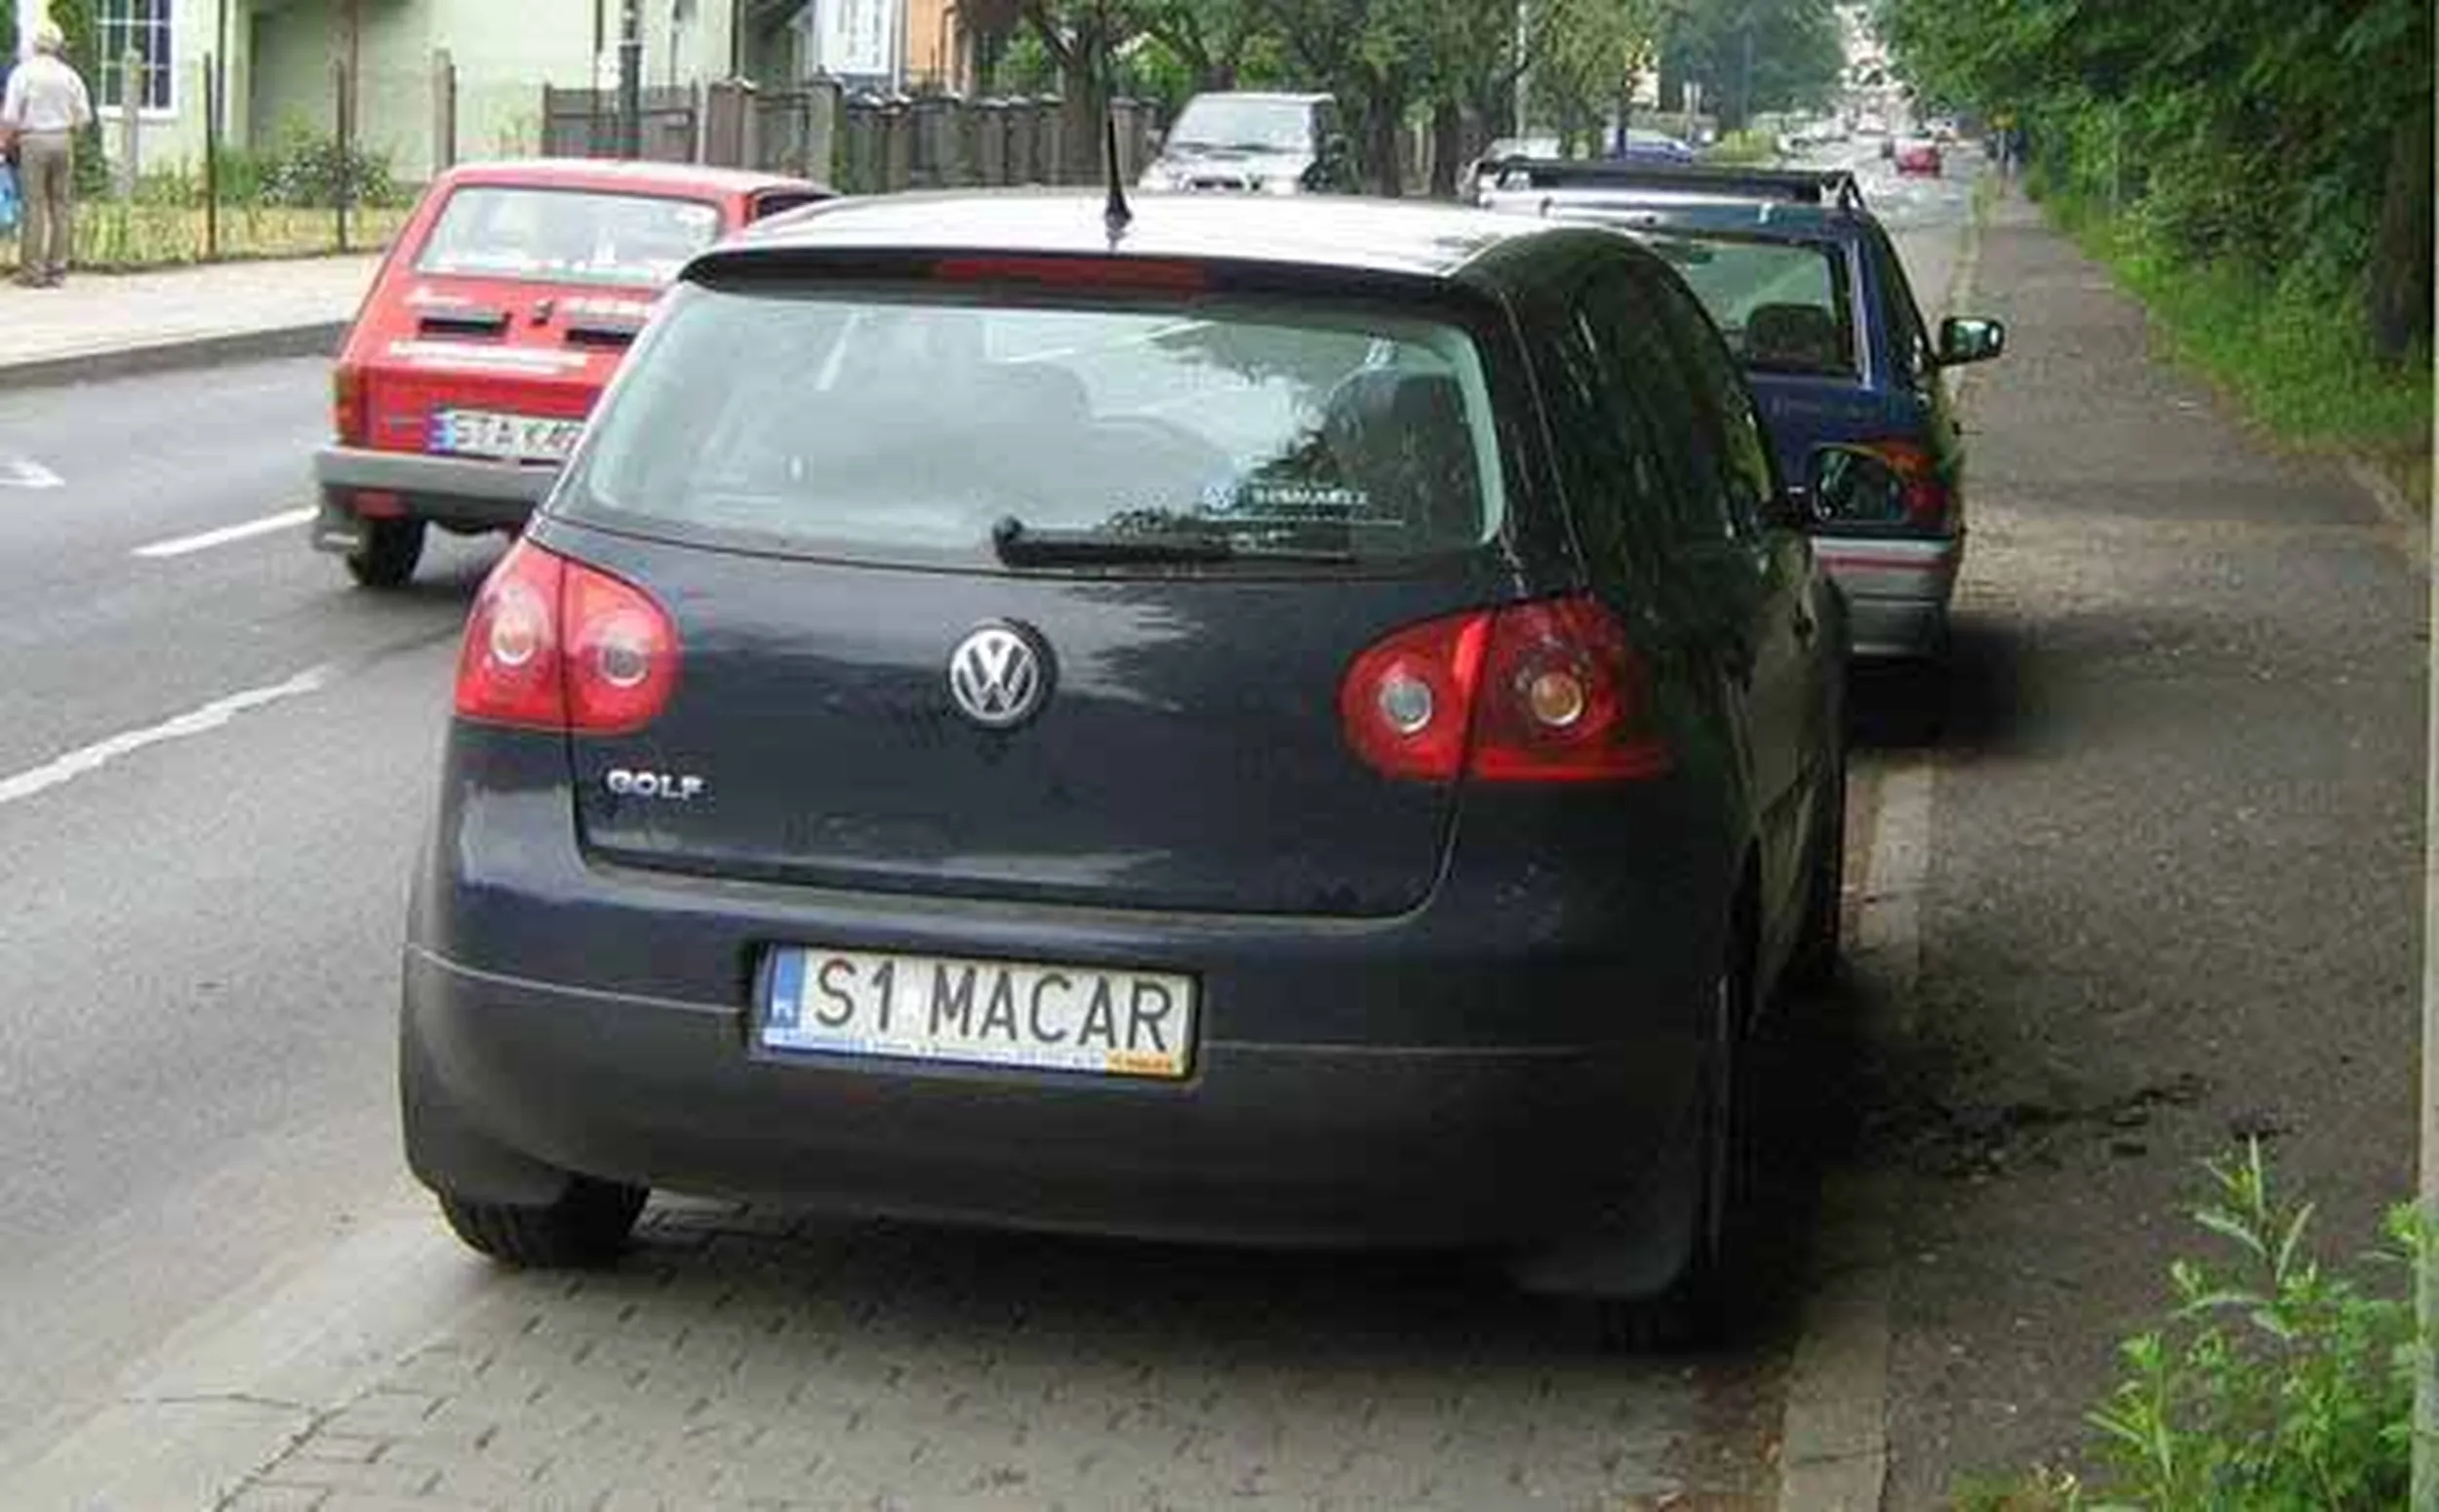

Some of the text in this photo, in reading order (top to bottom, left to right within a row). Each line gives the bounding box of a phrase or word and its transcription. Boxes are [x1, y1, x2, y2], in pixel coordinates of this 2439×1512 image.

[606, 768, 705, 801] GOLF
[814, 956, 1173, 1052] S1 MACAR
